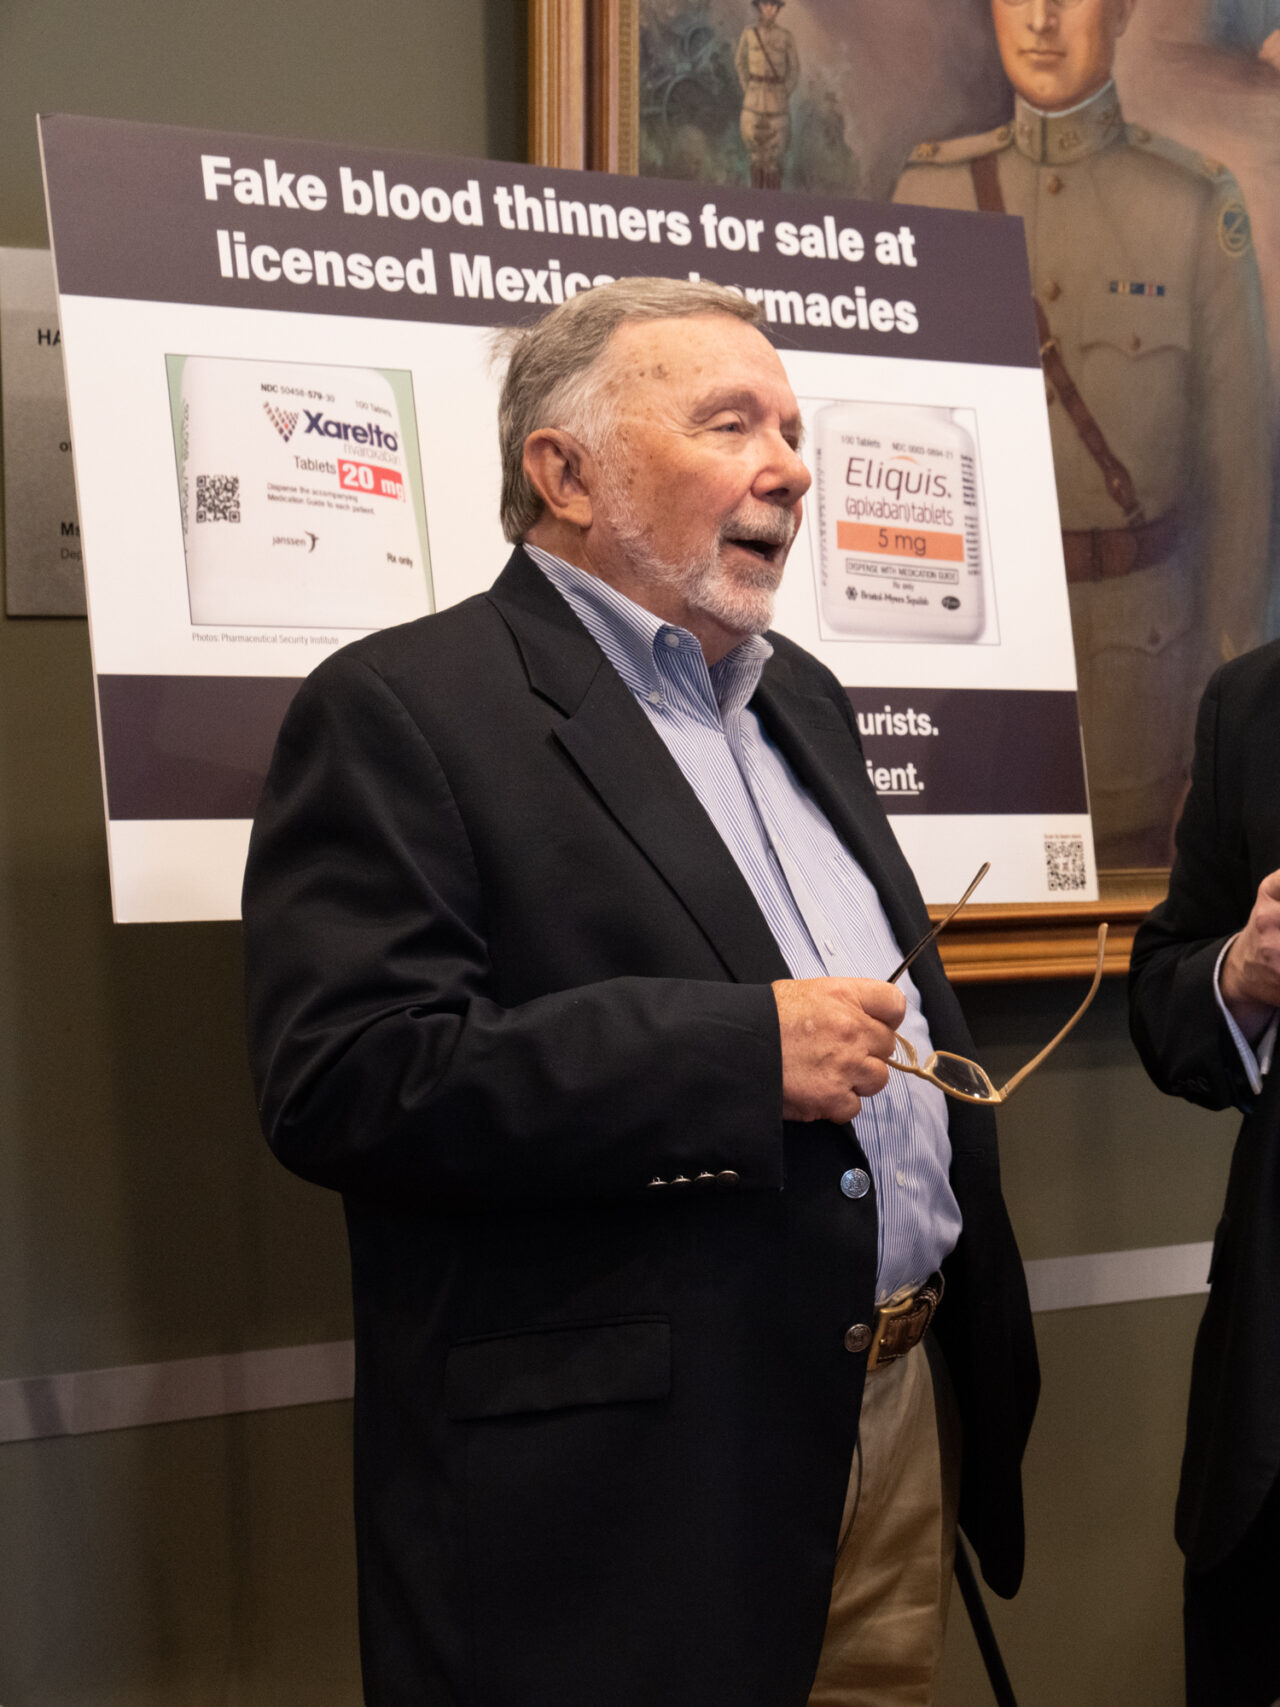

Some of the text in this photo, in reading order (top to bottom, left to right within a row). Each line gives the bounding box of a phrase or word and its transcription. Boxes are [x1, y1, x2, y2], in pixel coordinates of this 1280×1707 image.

[201, 154, 918, 267] Fake blood thinners for sale at
[216, 229, 438, 295] licensed
[450, 252, 616, 305] Mexic
[261, 383, 278, 393] NDC
[303, 409, 398, 451] Xarelto
[294, 456, 406, 503] Tablets 20 mg
[272, 534, 306, 547] janssen
[878, 528, 927, 557] 5 mg
[221, 633, 278, 644] Pharmaceutical
[279, 635, 308, 646] Security
[310, 635, 339, 645] Institute
[857, 705, 940, 736] urists.
[866, 760, 925, 790] ient.
